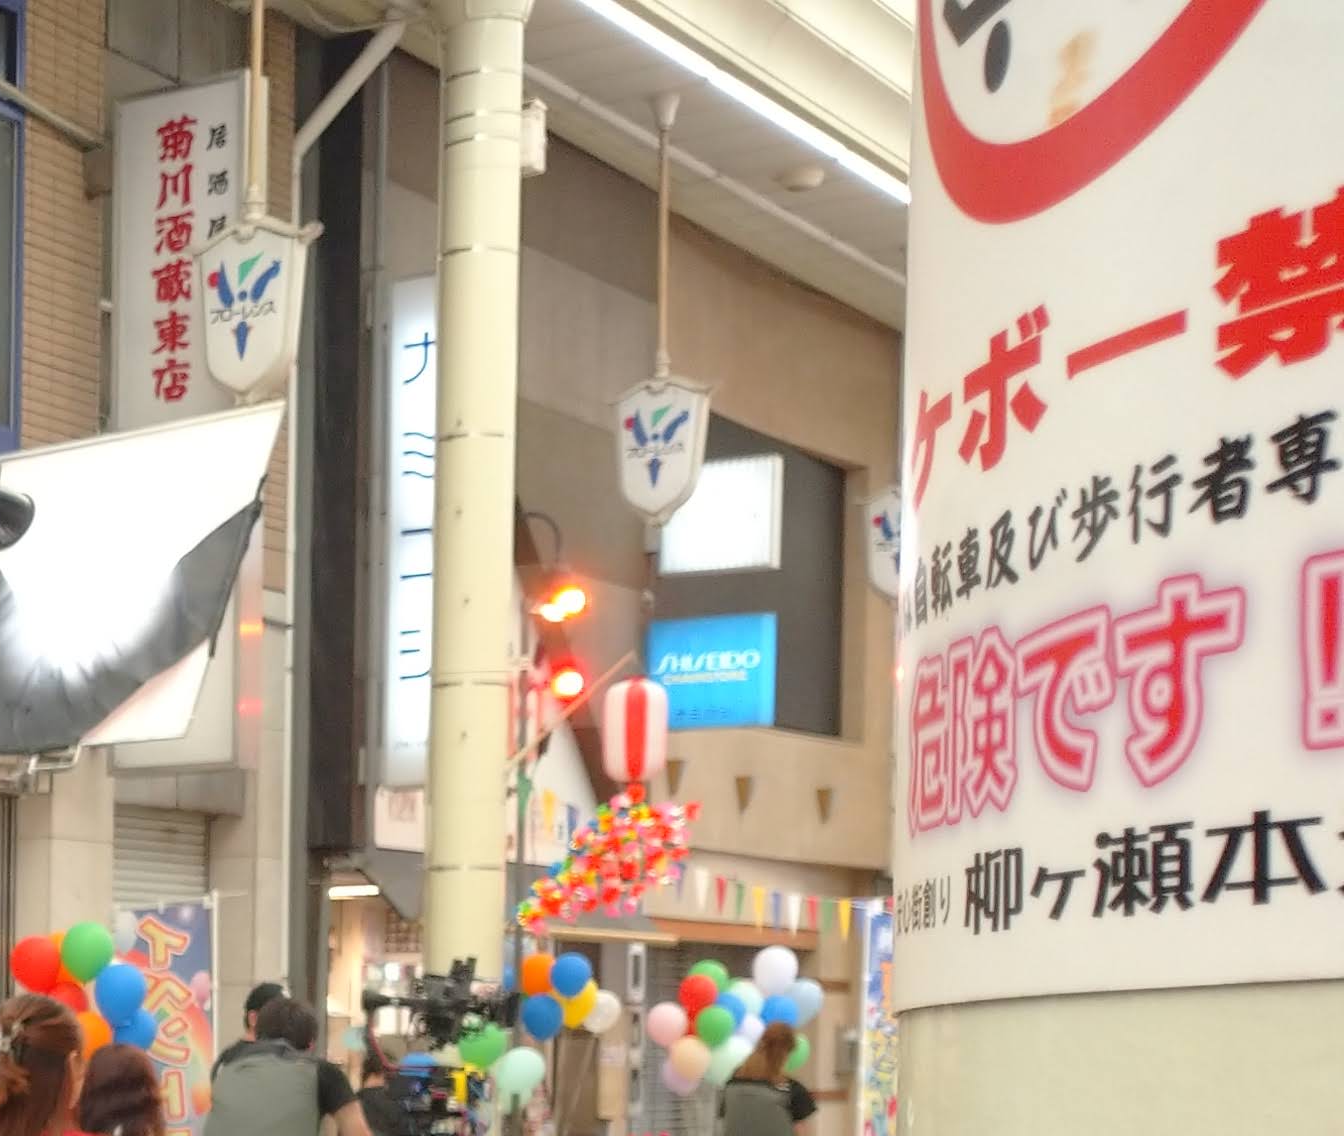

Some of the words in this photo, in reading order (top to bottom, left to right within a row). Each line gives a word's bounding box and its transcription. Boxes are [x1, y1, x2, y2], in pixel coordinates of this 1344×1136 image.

[150, 114, 198, 403] 菊川酒蔵東店
[904, 408, 1343, 635] 自転車及び歩行者専
[655, 648, 762, 675] SHISEIDO
